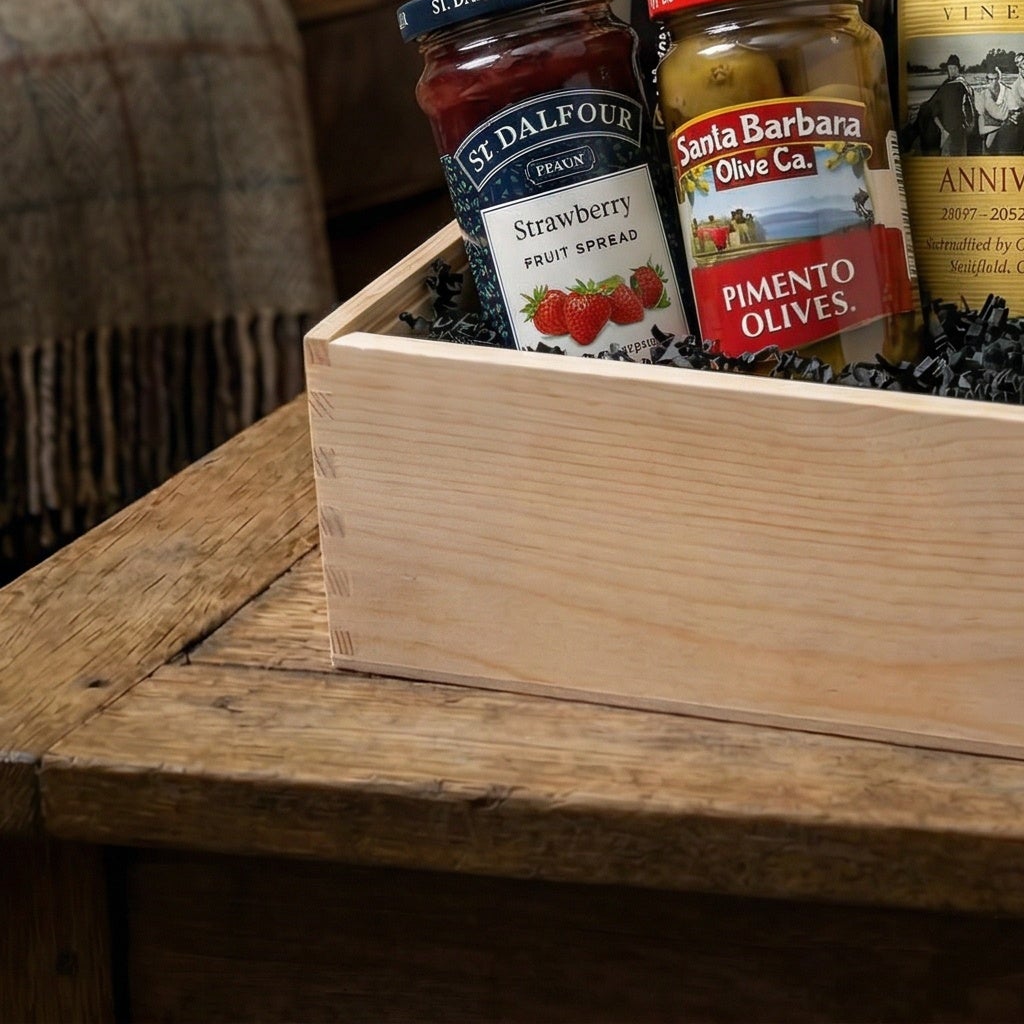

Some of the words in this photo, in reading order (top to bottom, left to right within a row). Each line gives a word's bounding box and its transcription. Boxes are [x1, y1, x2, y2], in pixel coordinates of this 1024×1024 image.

[494, 103, 633, 150] DALFOUR
[677, 124, 739, 167] Santa
[716, 156, 769, 184] Olive
[514, 196, 632, 241] Strawberry
[524, 245, 569, 269] FRUIT
[576, 229, 638, 254] SPREAD
[996, 237, 1012, 256] by
[722, 259, 855, 311] PIMENTO
[741, 291, 856, 338] OLIVES.
